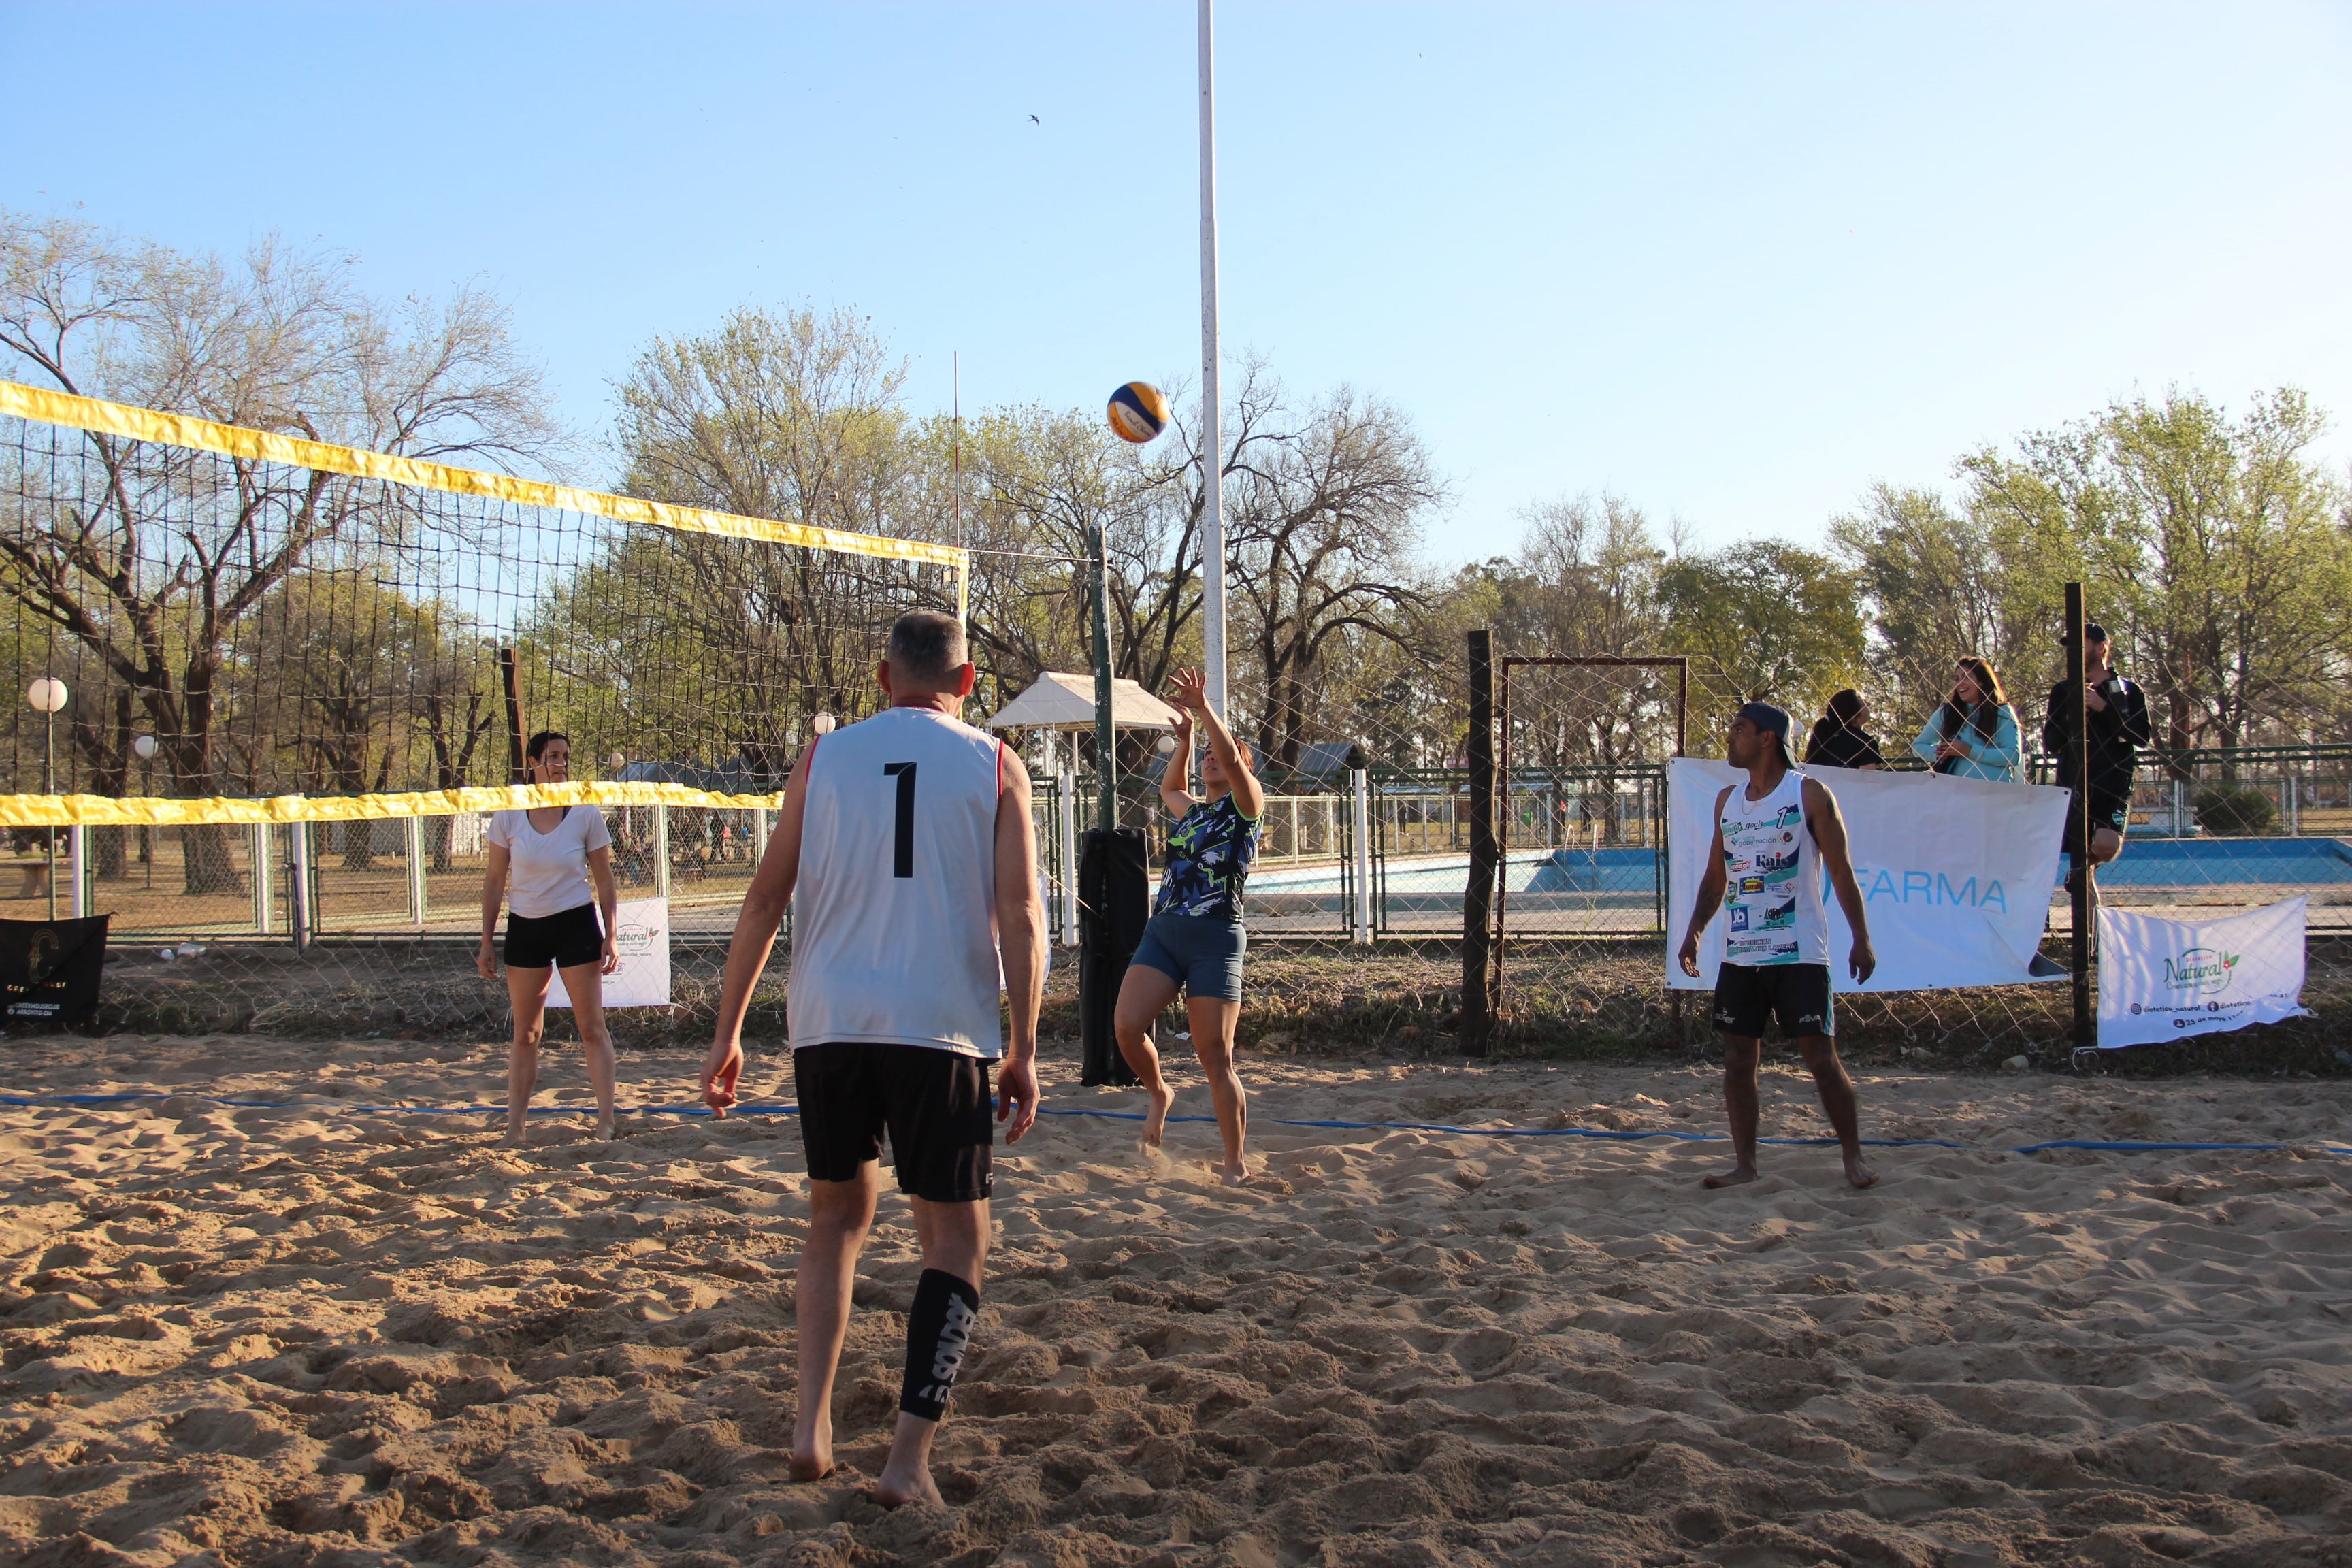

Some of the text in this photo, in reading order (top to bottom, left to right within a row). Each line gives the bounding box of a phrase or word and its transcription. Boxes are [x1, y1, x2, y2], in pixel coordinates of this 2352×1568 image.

[883, 762, 917, 878] 1
[1744, 820, 1763, 830] goals
[1776, 806, 1789, 829] 1
[616, 926, 649, 941] atural
[2163, 951, 2223, 983] Natural
